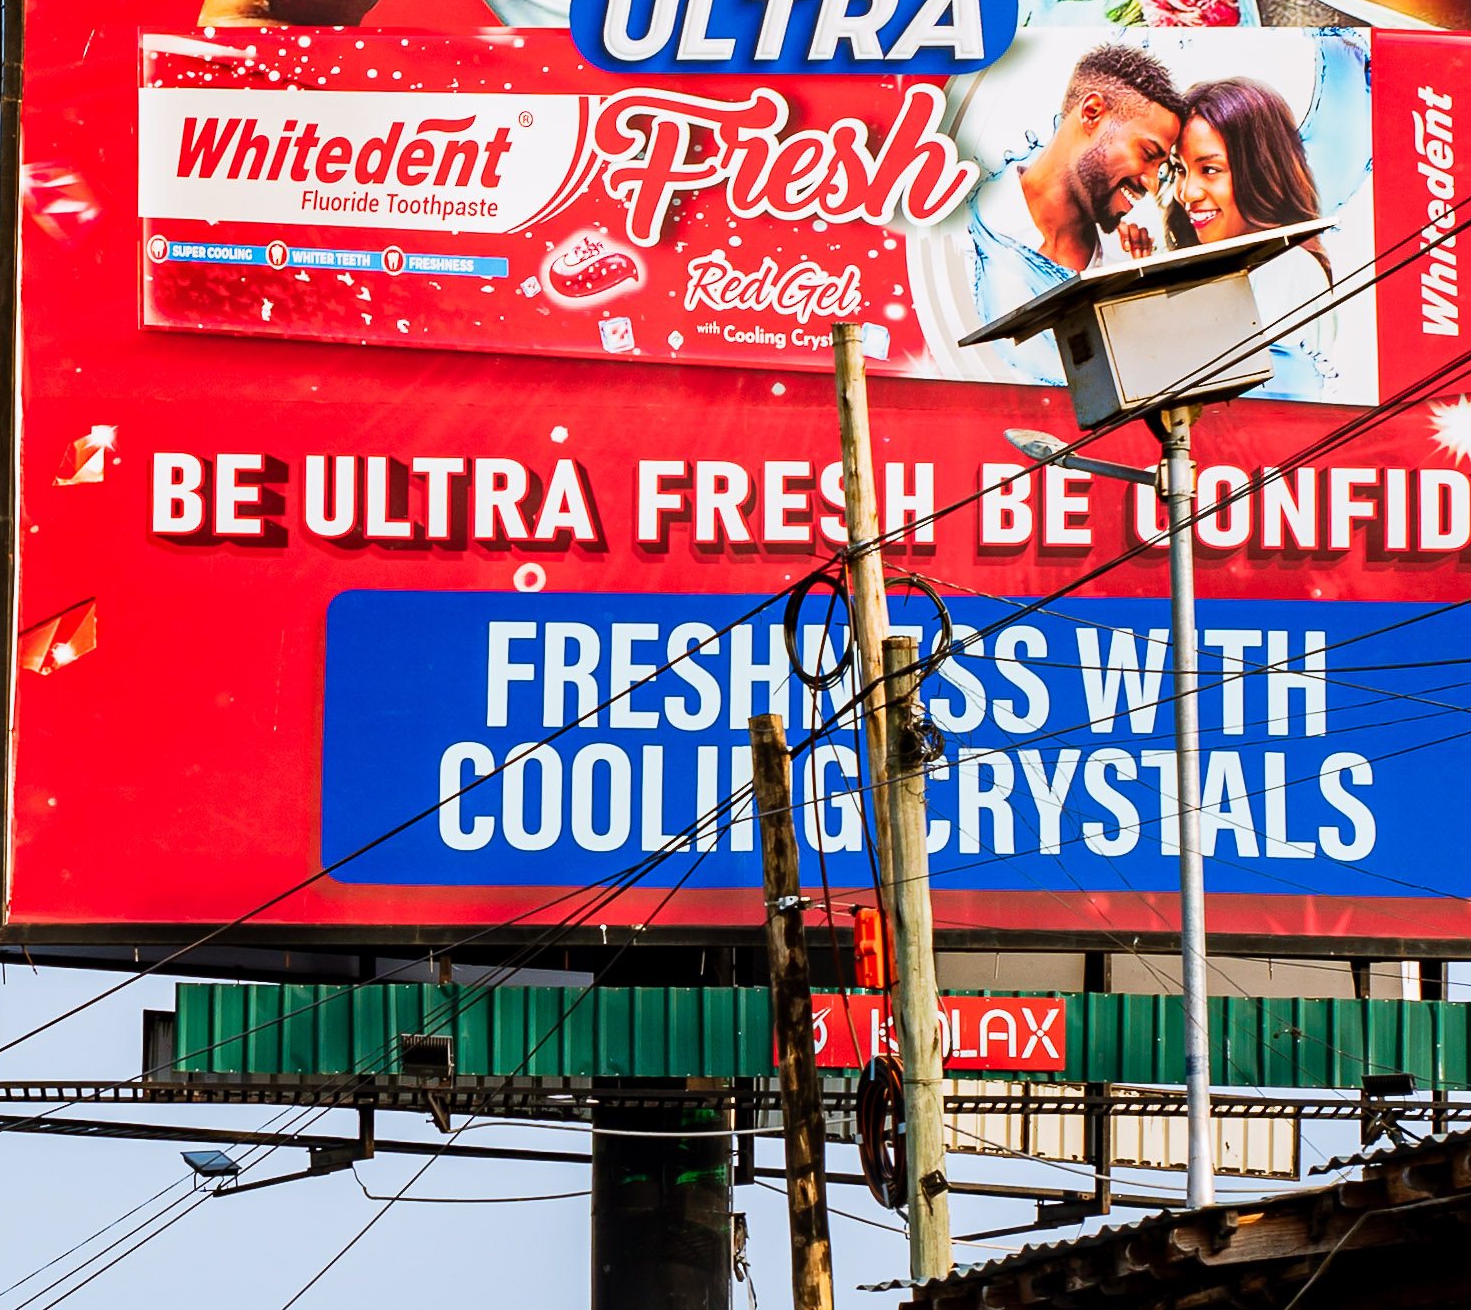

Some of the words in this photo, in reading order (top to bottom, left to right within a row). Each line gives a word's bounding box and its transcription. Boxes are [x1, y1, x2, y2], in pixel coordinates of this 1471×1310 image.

[176, 114, 513, 189] Whitedent
[595, 83, 981, 247] Fresh
[301, 190, 380, 213] Fluoride
[386, 193, 499, 221] Toothpaste
[1411, 85, 1459, 337] Whitedent
[171, 246, 207, 259] SUPER
[207, 247, 254, 262] COOLING
[292, 251, 336, 265] WHITER
[336, 254, 371, 267] TEETH
[408, 257, 475, 272] FRESHNESS
[686, 253, 774, 311] Red
[773, 261, 862, 323] Gel
[696, 321, 721, 335] with
[723, 325, 787, 349] Cooling
[152, 453, 263, 536] BE
[304, 456, 596, 540] ULTRA
[636, 460, 936, 544] FRESH
[981, 462, 1093, 546] BE
[487, 622, 1050, 736] FRESHNSS
[1075, 628, 1327, 737] WTH
